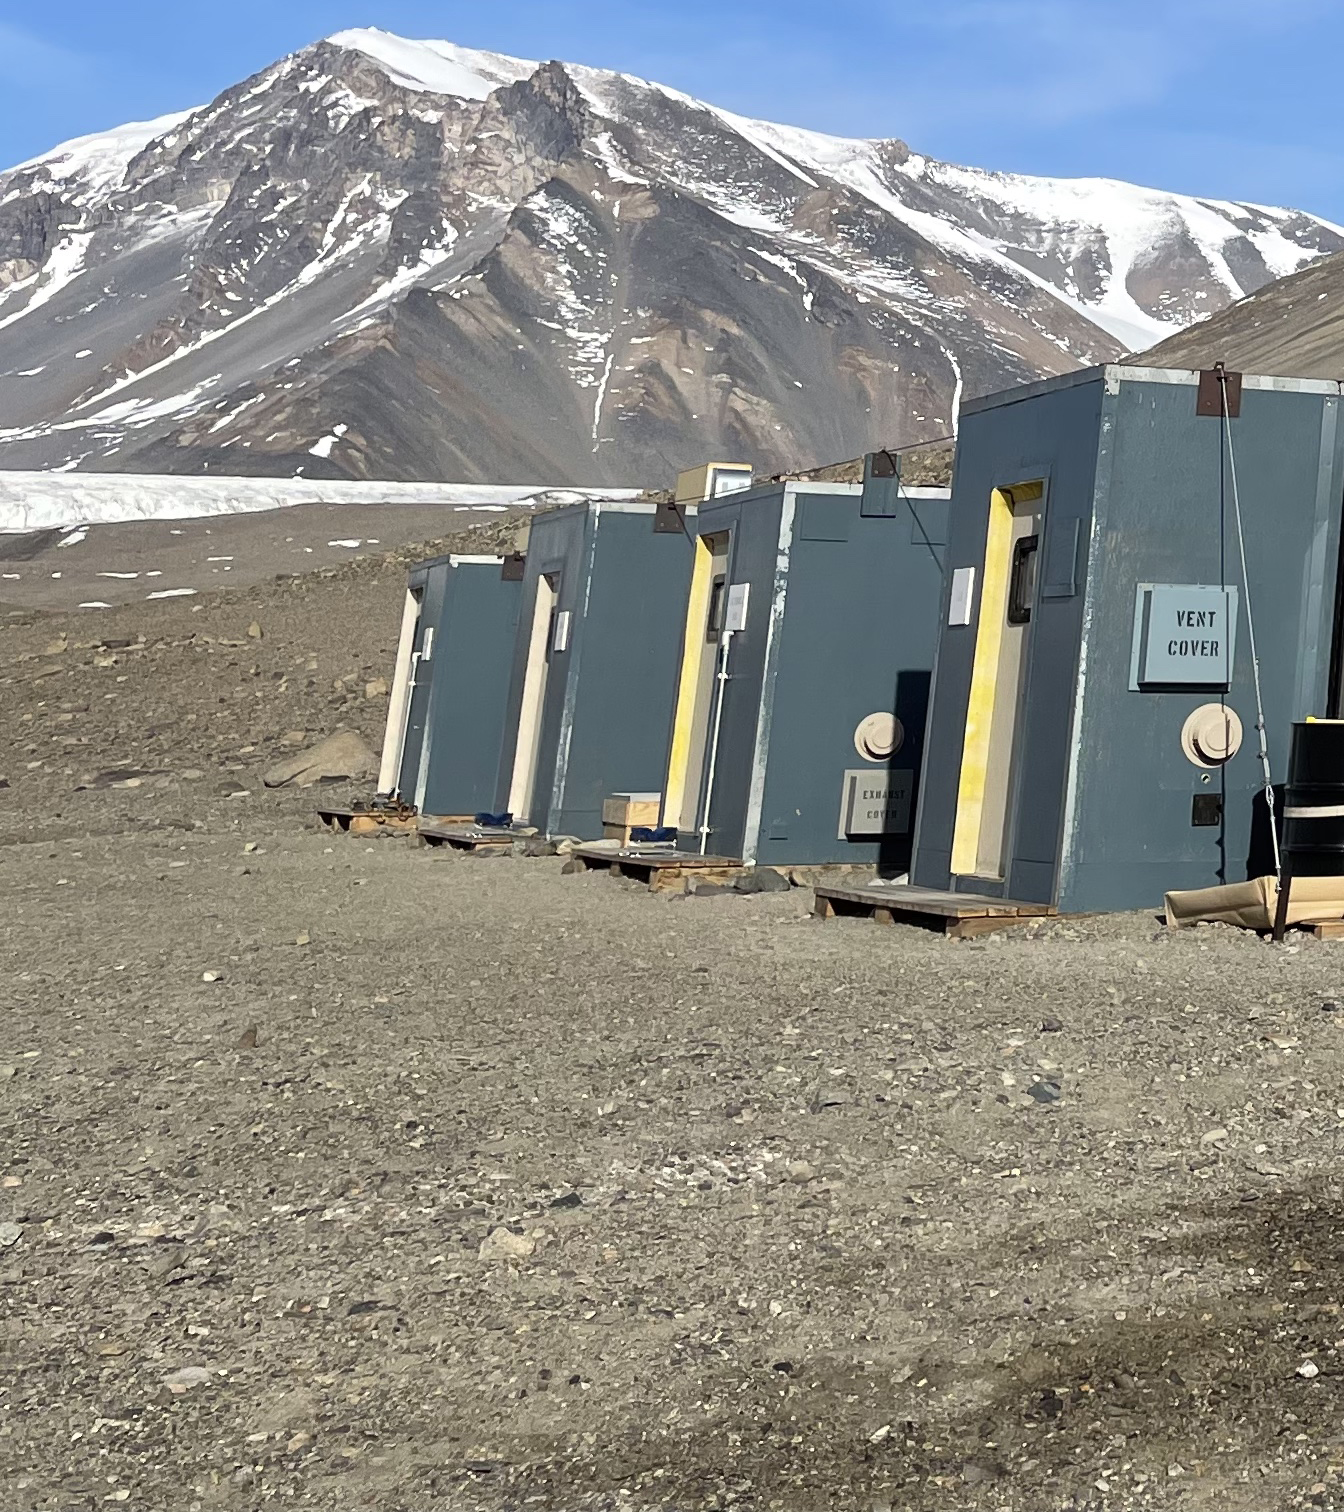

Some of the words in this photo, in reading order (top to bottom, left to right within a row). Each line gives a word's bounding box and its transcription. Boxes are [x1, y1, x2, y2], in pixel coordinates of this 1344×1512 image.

[1176, 610, 1216, 627] VENT
[1168, 640, 1219, 657] COVER
[862, 789, 906, 800] EXHAUST
